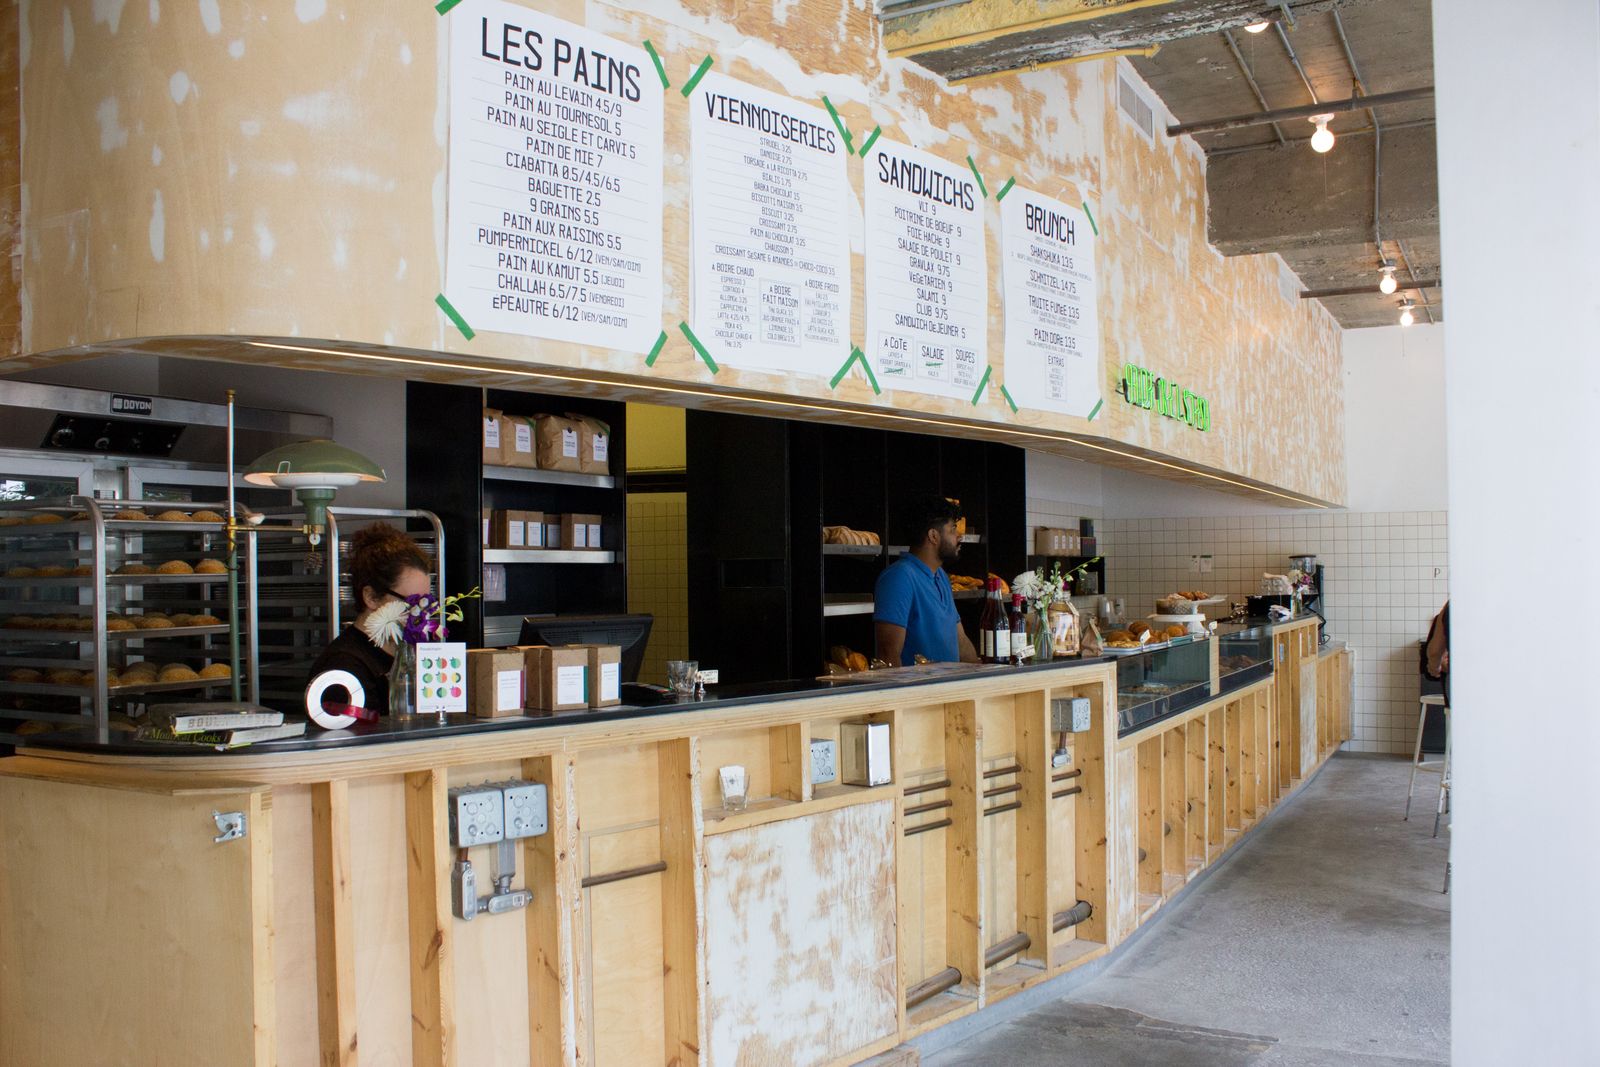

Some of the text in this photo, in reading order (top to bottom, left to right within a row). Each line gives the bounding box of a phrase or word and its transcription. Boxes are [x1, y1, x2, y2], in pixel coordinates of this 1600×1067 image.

[482, 17, 640, 102] LES PAINS
[505, 71, 622, 118] PAIN AU LEVAIN 4.5/9
[505, 91, 622, 137] PAIN AU TOURNESOL 5
[705, 91, 835, 154] VIENNOISERIES
[487, 106, 516, 127] PAIN
[520, 115, 534, 132] AU
[537, 119, 578, 143] SEIGLE
[582, 132, 593, 146] ET
[597, 136, 627, 157] CARVI
[526, 137, 554, 157] PAIN
[558, 146, 571, 161] DE
[574, 149, 593, 165] MIE
[760, 137, 779, 151] STRUDEL
[506, 152, 621, 193] CIABATTA 0.5/4.5/6.5
[744, 155, 765, 169] TORSADE
[770, 163, 777, 172] LA
[777, 165, 797, 177] RICOTTA
[878, 152, 975, 212] SANDWICHS
[528, 177, 601, 207] BAGUETTE 2.5
[751, 192, 776, 206] BISCOTTI
[776, 198, 795, 211] MAISON
[770, 185, 792, 199] CHOCOLAT
[530, 198, 599, 226] 9 GRAINS 5.5
[761, 206, 783, 219] BISCUIT
[894, 206, 925, 227] POITRINE
[925, 217, 934, 229] DE
[935, 217, 954, 234] BOEUF
[503, 212, 622, 251] PAIN AUX RAISINS 5.5
[759, 217, 786, 232] CROISSANT
[907, 225, 922, 240] FOIE
[1025, 202, 1075, 246] BRUNCH
[478, 228, 563, 259] PUMPERNICKEL
[566, 245, 593, 264] 6/12
[750, 227, 764, 238] PAIN
[764, 231, 771, 239] AU
[771, 232, 795, 246] CHOCOLAT
[715, 244, 746, 258] CROISSANT
[764, 242, 790, 255] CHAUSSON
[898, 237, 920, 255] SALADE
[921, 245, 930, 257] DE
[930, 249, 952, 264] POULET
[1030, 244, 1060, 265] SHAKSHUKA
[498, 253, 527, 271] PAIN
[530, 260, 544, 275] AU
[547, 262, 580, 281] KAMUT
[584, 269, 599, 285] 5.5
[716, 262, 735, 274] BOIRE
[736, 265, 755, 277] CHAUD
[909, 256, 935, 273] GRAVLAX
[498, 274, 546, 296] CHALLAH
[549, 282, 587, 302] 6.5/7.5
[808, 279, 824, 291] BOIRE
[1030, 269, 1060, 290] SCHNITZEL
[773, 284, 792, 296] BOIRE
[916, 287, 939, 304] SALAMI
[777, 296, 799, 309] MAISON
[916, 303, 932, 317] CLUB
[1028, 294, 1050, 312] TRUITE
[552, 303, 579, 322] 6/12
[895, 313, 928, 332] SANDWICH
[1034, 328, 1049, 343] PAIN
[921, 345, 945, 361] SALADE
[955, 348, 975, 364] SOUPES
[1047, 355, 1065, 368] EXTRAS
[123, 398, 152, 410] DOYON
